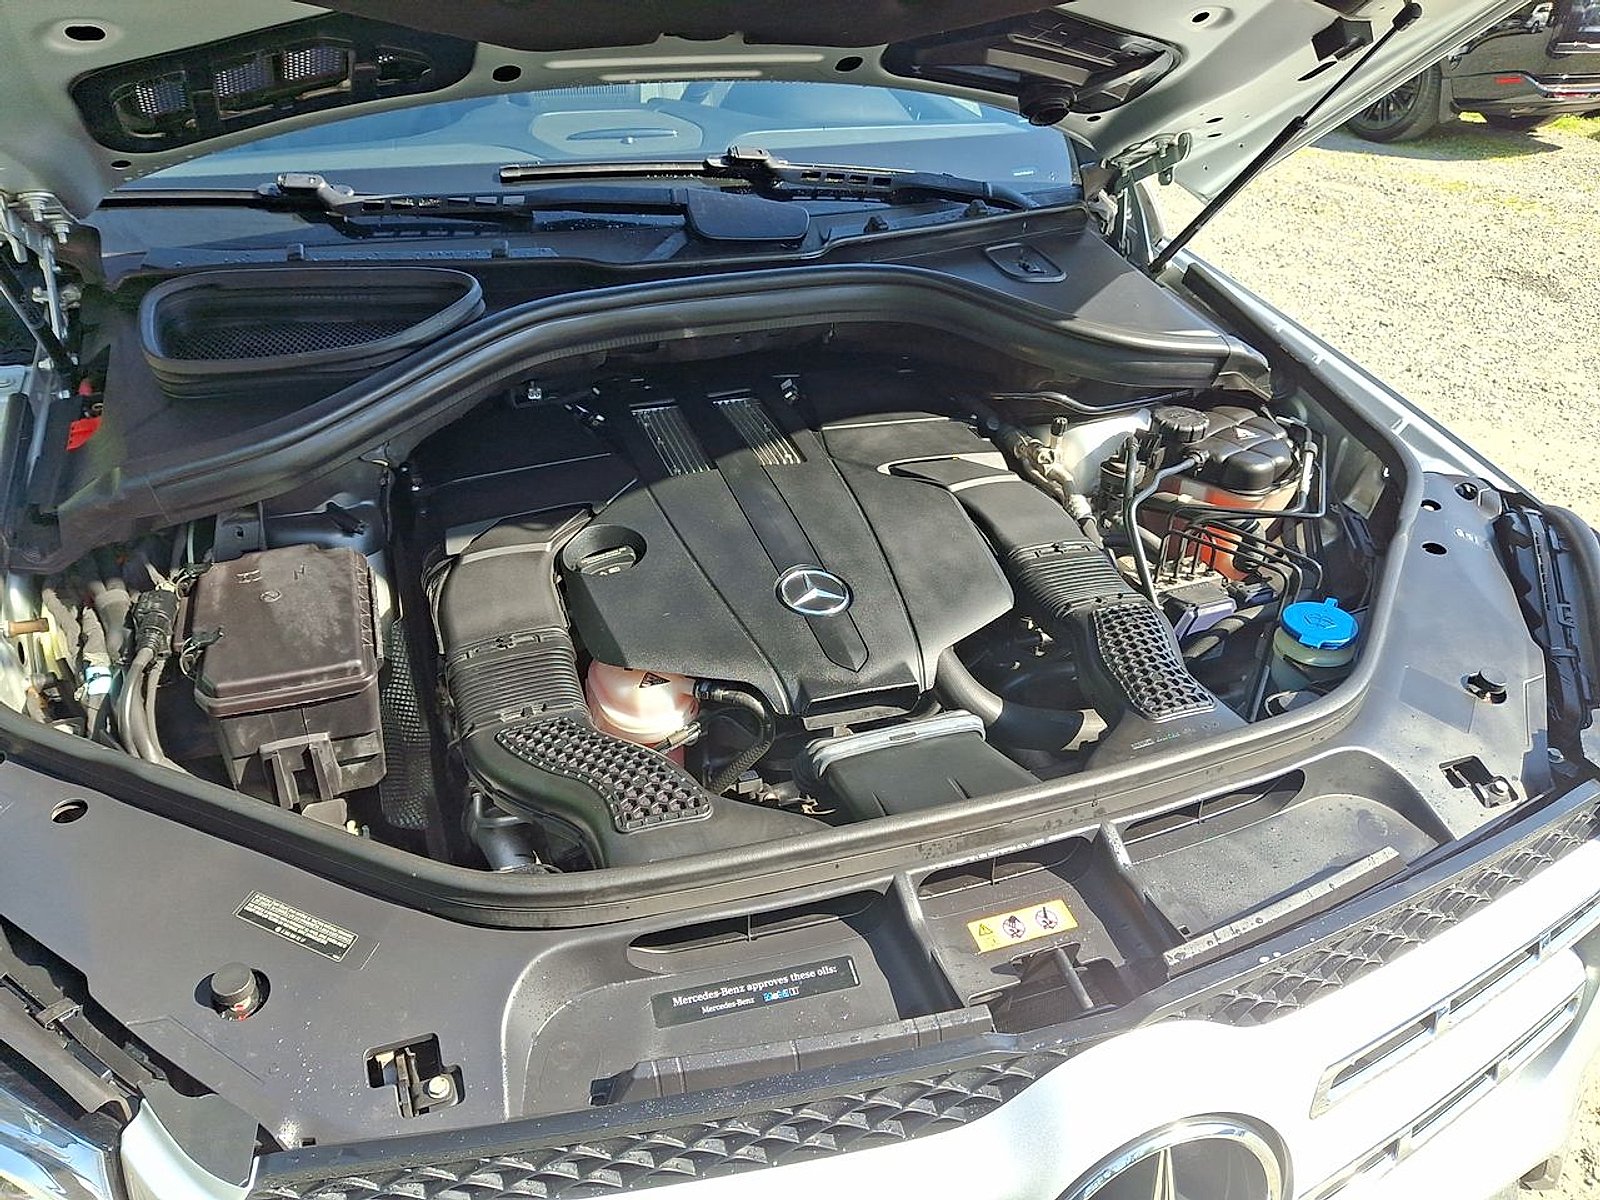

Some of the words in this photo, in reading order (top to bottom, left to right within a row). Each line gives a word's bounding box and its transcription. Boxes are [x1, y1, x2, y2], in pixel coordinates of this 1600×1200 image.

[672, 984, 745, 1007] Mercedes-Benz
[746, 976, 788, 994] approves
[790, 970, 816, 982] these
[817, 965, 837, 977] oils:
[701, 997, 755, 1014] Mercedes-Benz
